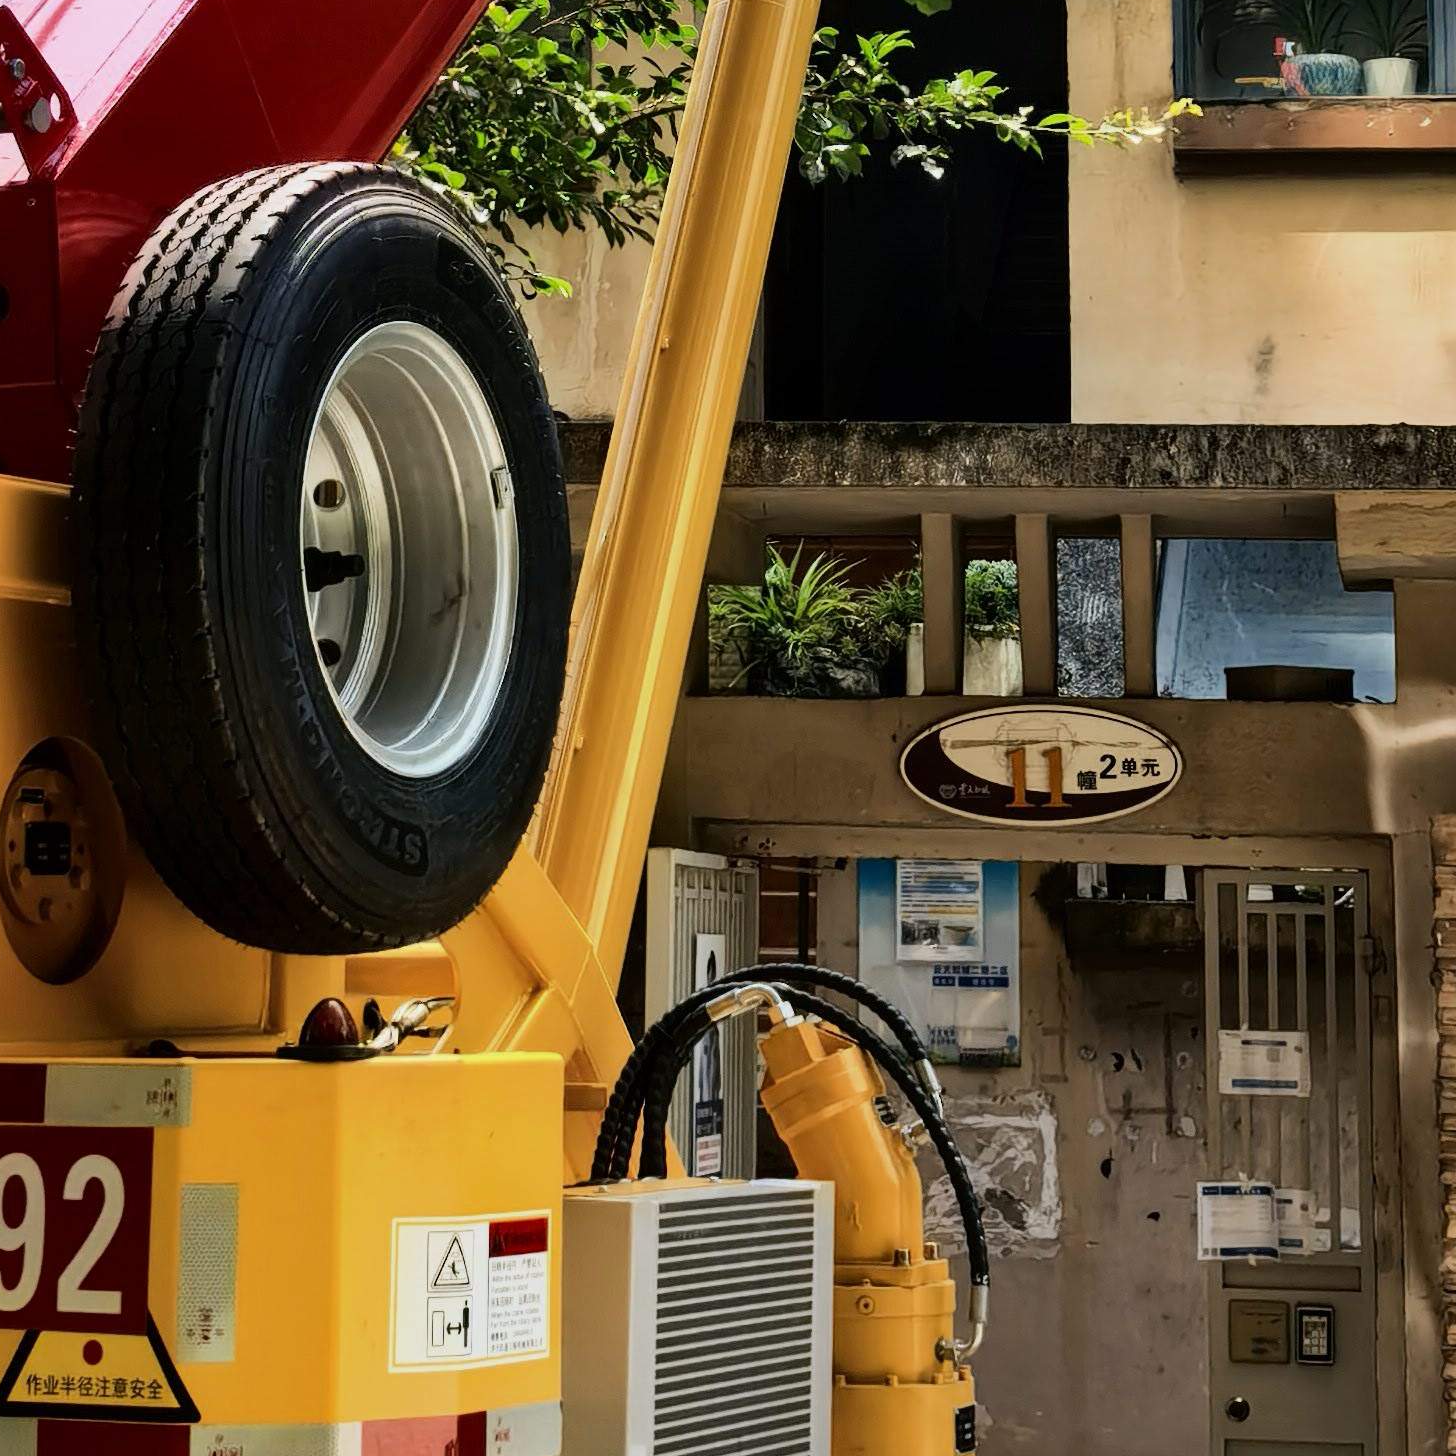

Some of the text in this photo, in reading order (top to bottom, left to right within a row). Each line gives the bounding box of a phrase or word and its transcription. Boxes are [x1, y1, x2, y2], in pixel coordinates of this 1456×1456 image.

[1004, 746, 1072, 808] 11
[1099, 753, 1161, 780] 2单元
[1077, 770, 1098, 791] 幢
[26, 1373, 163, 1400] 作业半径注意安全
